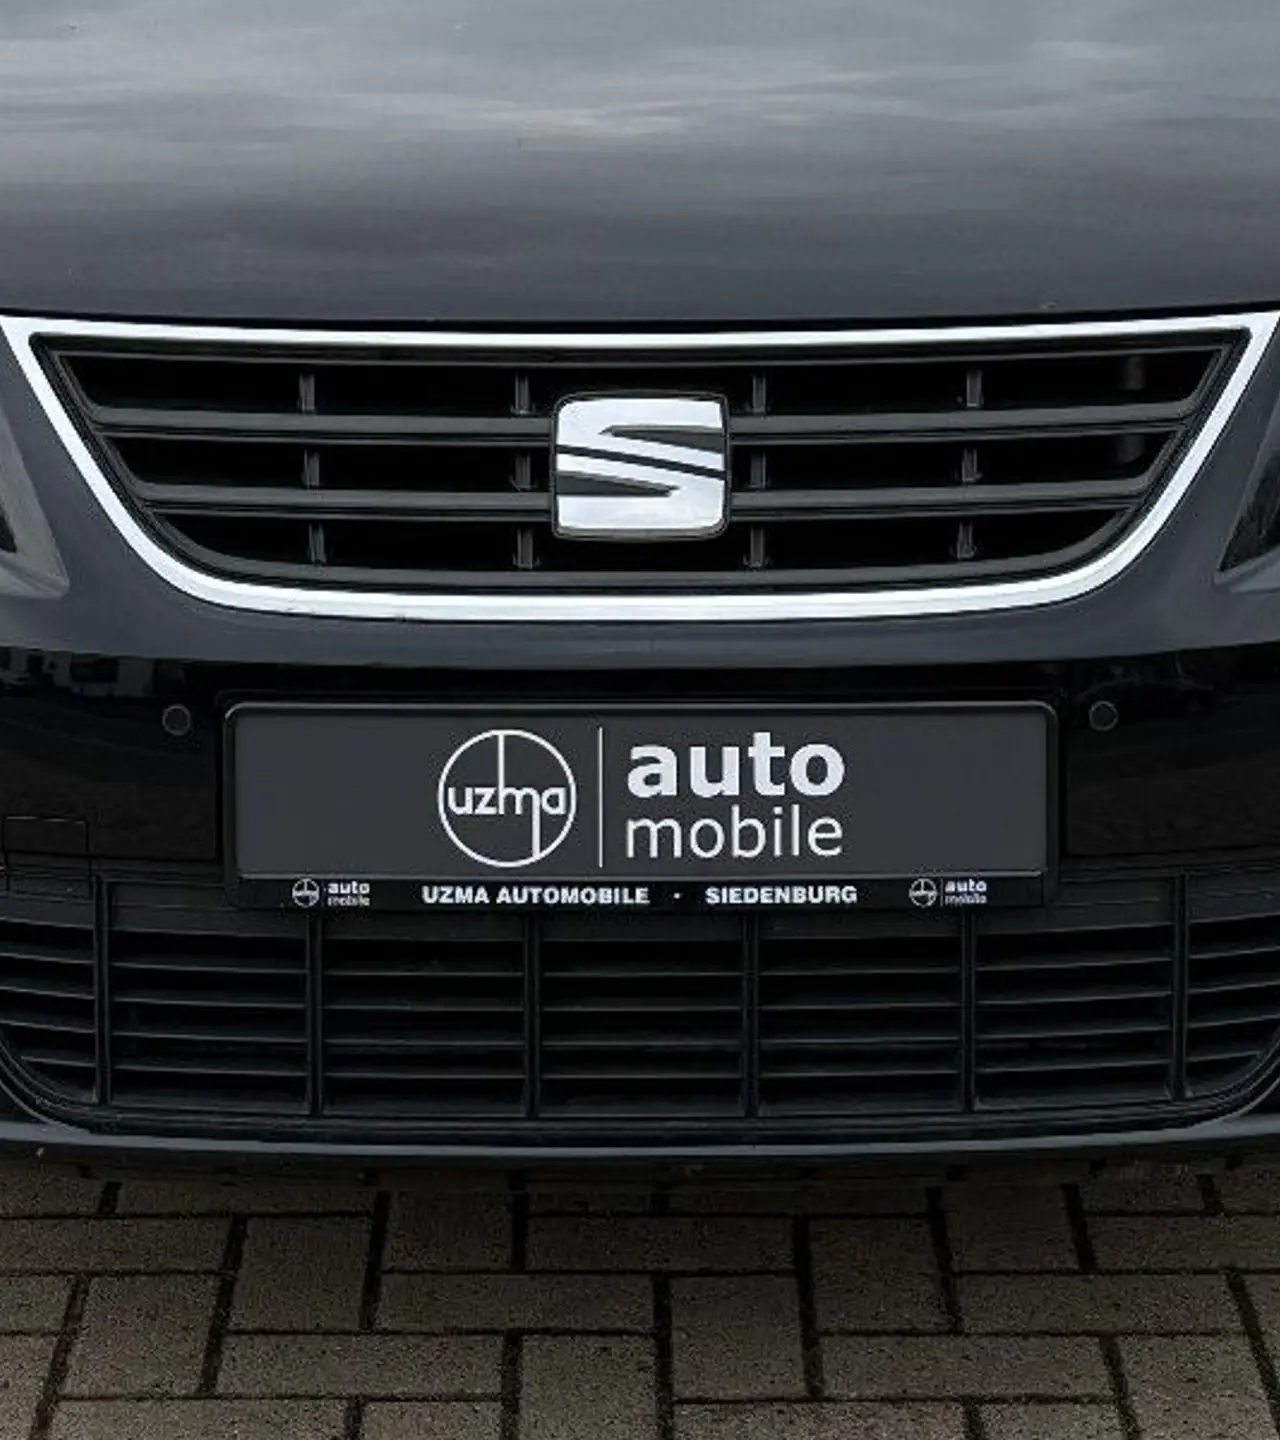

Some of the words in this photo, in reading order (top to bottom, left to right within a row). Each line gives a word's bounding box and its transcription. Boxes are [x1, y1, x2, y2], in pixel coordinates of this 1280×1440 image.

[627, 731, 845, 798] auto
[627, 804, 844, 858] mobile
[327, 880, 371, 894] auto
[422, 885, 490, 904] UZMA
[495, 886, 650, 905] AUTOMOBILE
[705, 885, 858, 905] SIEDENBURG
[944, 878, 988, 893] auto
